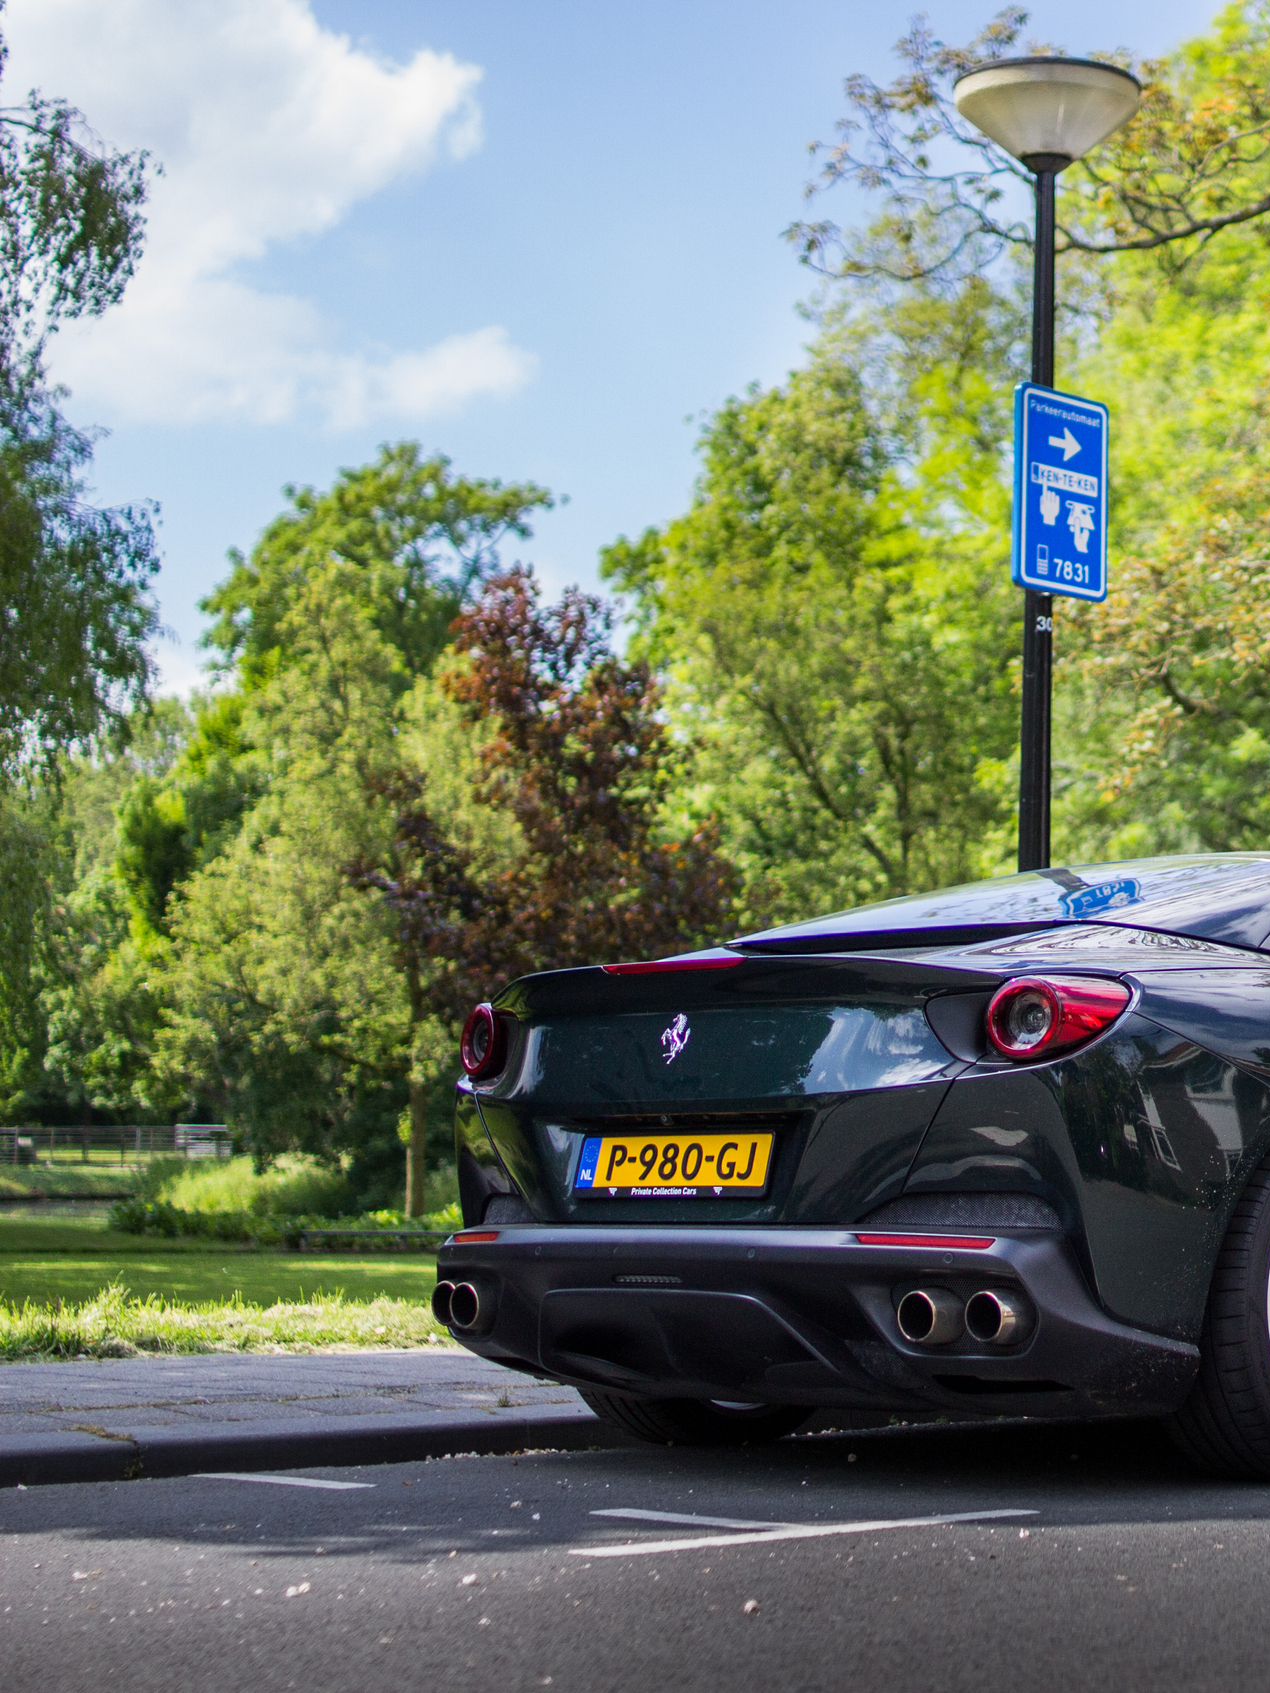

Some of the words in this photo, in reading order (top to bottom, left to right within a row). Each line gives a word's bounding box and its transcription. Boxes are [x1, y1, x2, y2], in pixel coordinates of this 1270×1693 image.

[1053, 558, 1089, 584] 7831
[605, 1142, 758, 1181] P-980-GJ
[580, 1169, 593, 1181] NL
[630, 1187, 652, 1196] Private
[652, 1186, 682, 1196] Collection
[682, 1186, 697, 1196] Cars
